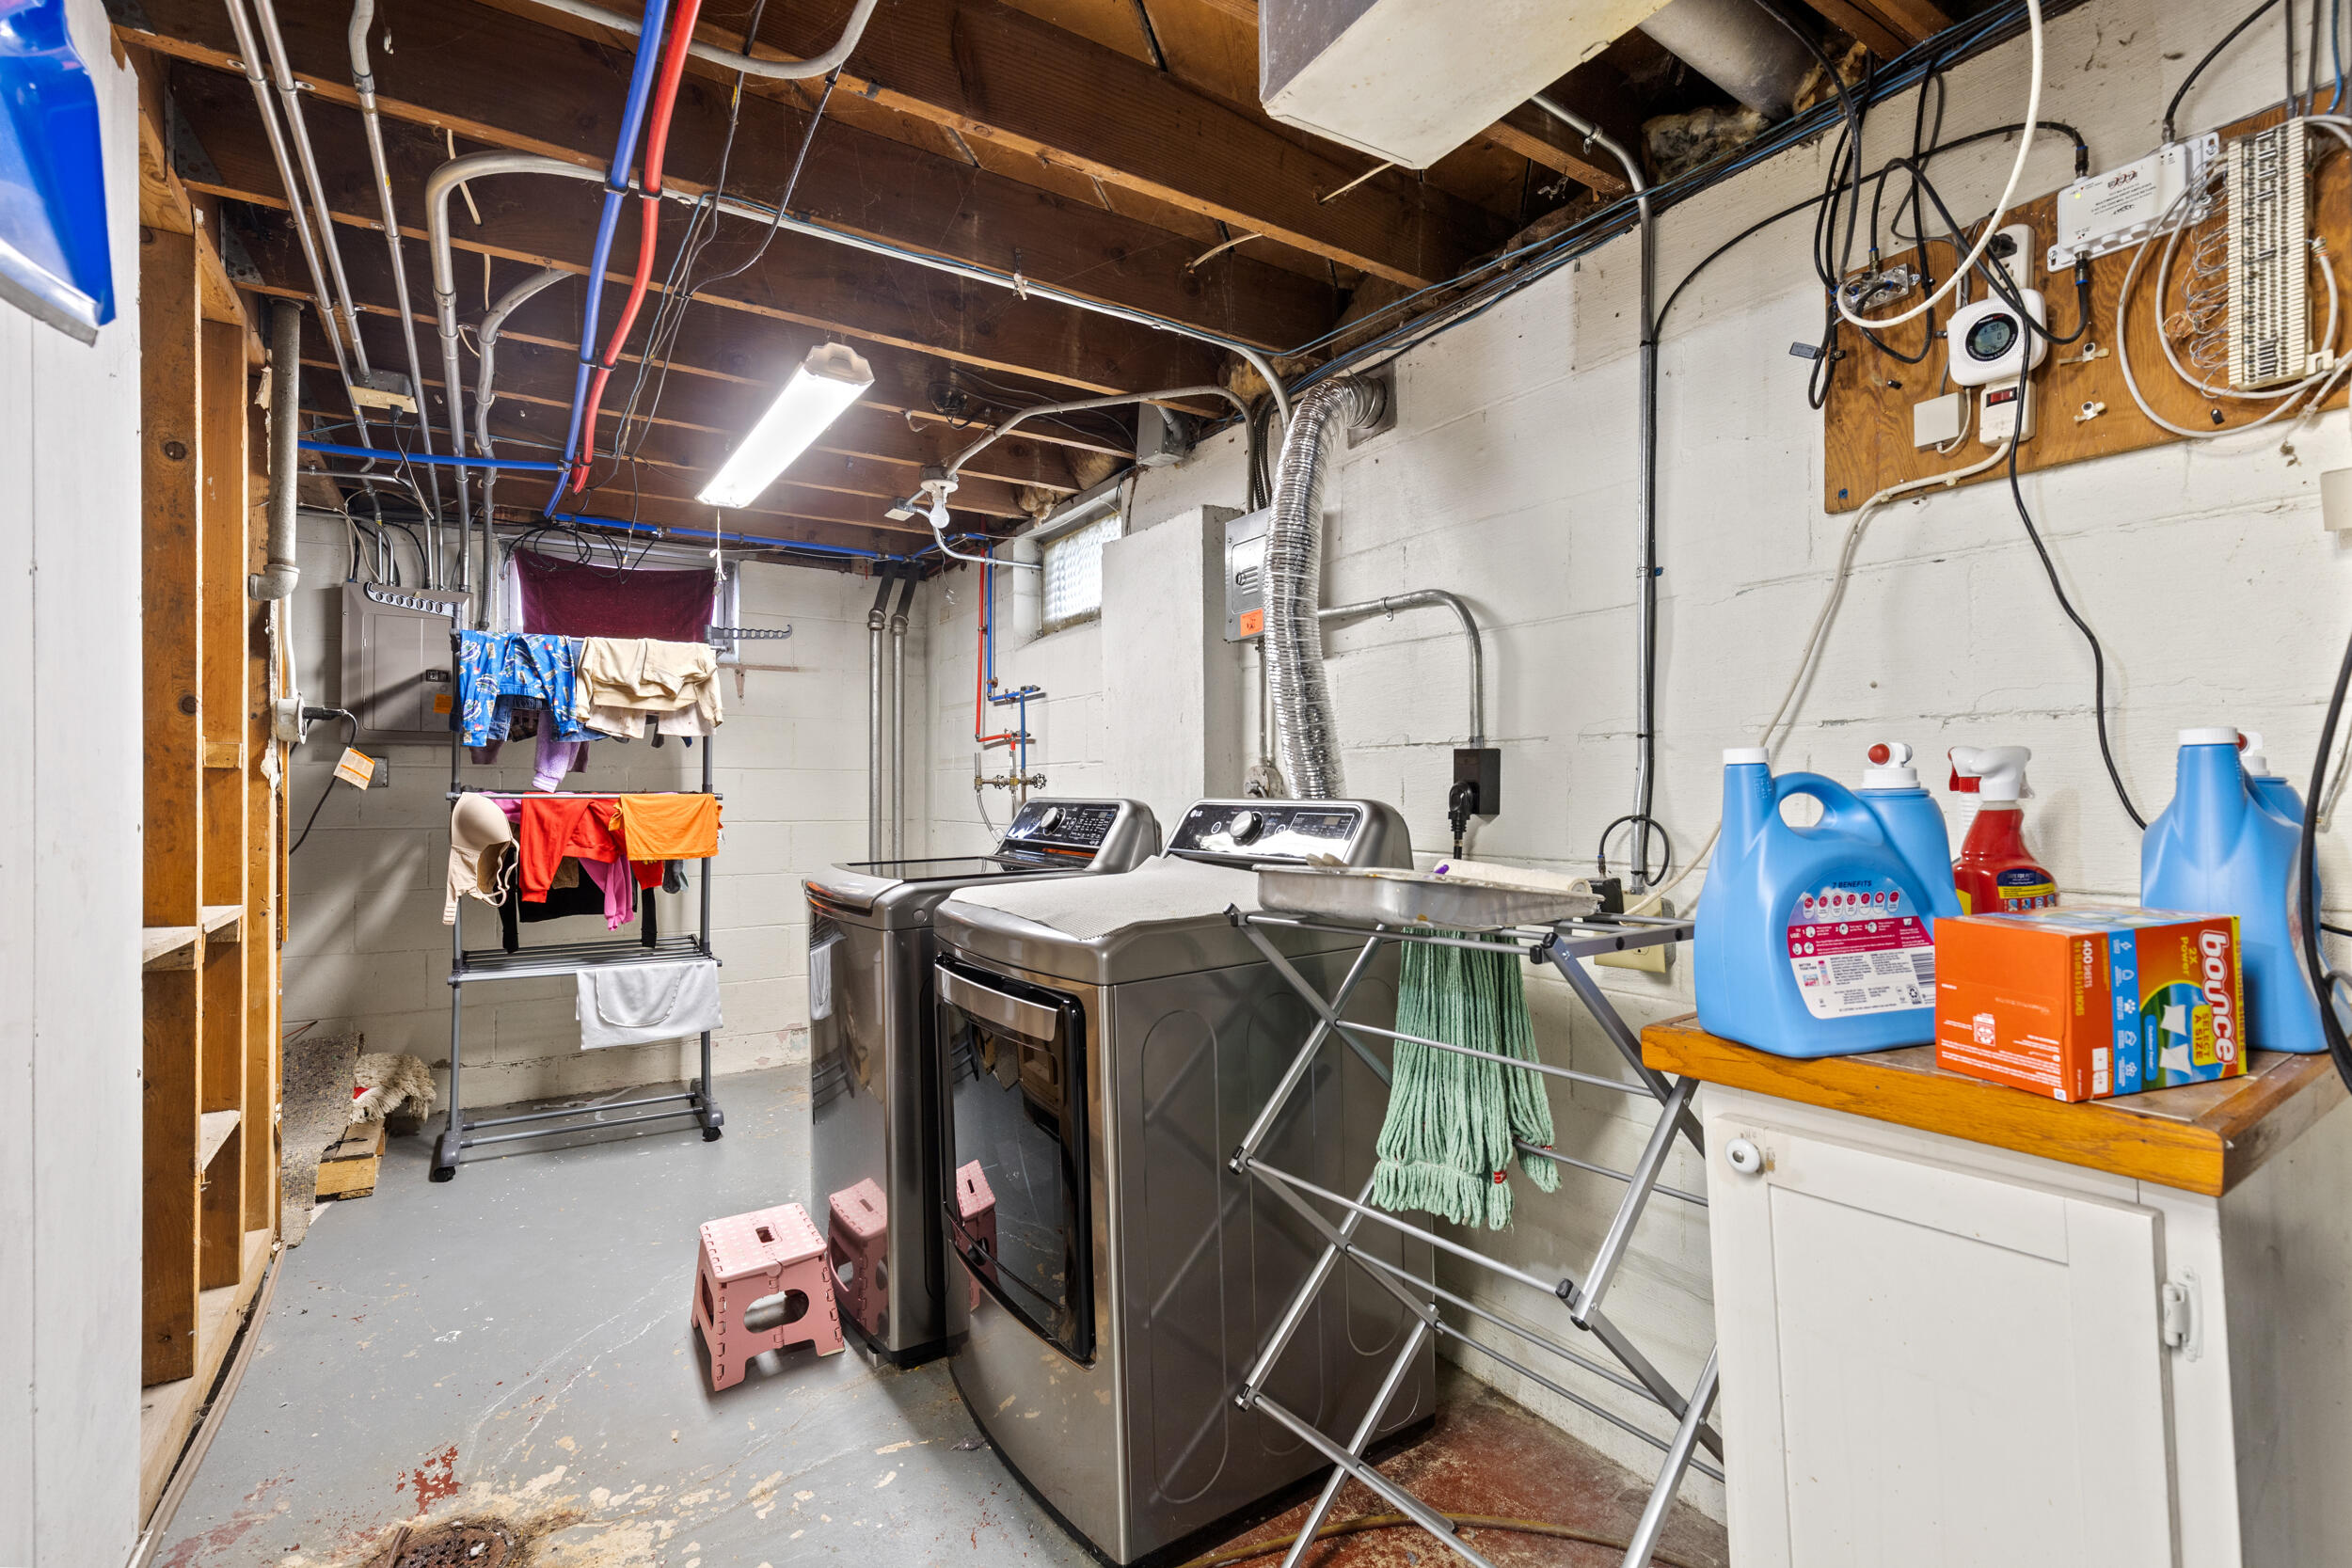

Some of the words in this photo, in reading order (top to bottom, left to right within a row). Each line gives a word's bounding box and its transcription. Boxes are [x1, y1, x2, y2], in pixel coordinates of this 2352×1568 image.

[1838, 879, 1872, 889] BENEFITS
[2082, 940, 2093, 964] 400
[2180, 936, 2190, 976] Power
[2188, 947, 2199, 965] 2X
[2201, 931, 2235, 1062] bounce
[2195, 1014, 2202, 1024] A
[2195, 1029, 2203, 1060] SIZE
